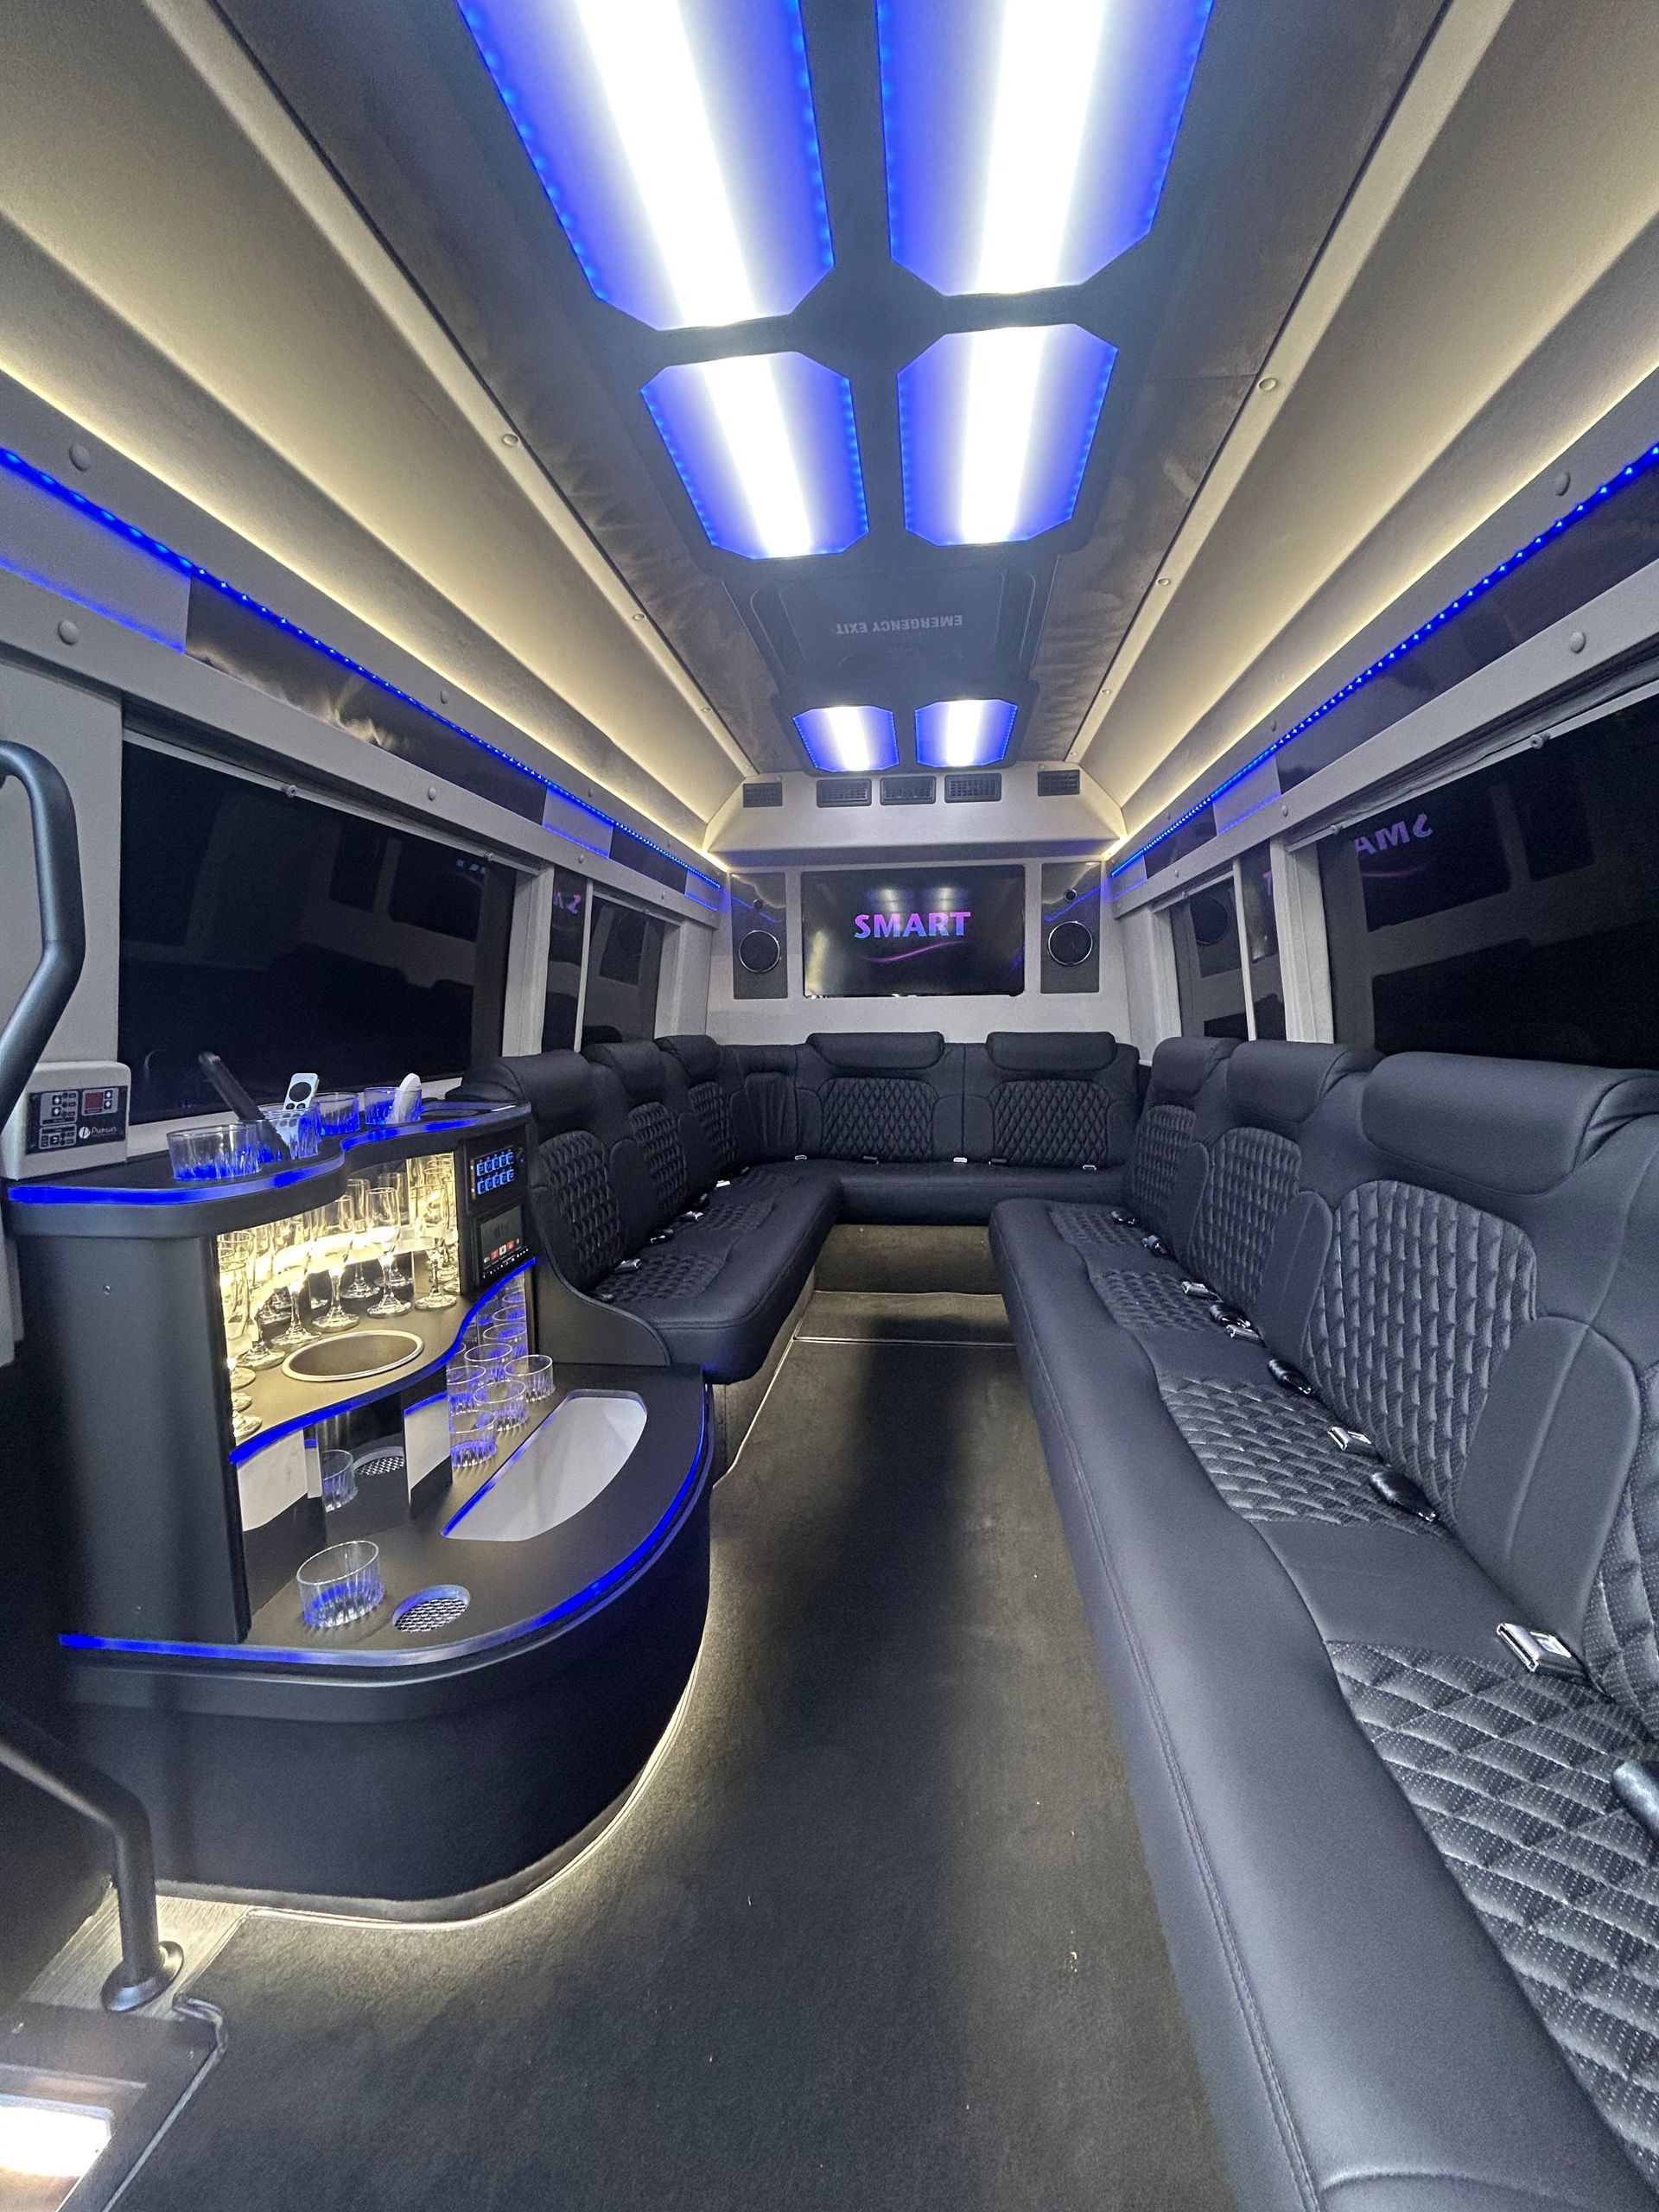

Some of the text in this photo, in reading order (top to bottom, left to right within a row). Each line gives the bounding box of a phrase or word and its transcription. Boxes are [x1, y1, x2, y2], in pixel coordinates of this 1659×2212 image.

[836, 614, 963, 635] EMERGENCY EXIT
[854, 912, 971, 939] SMART
